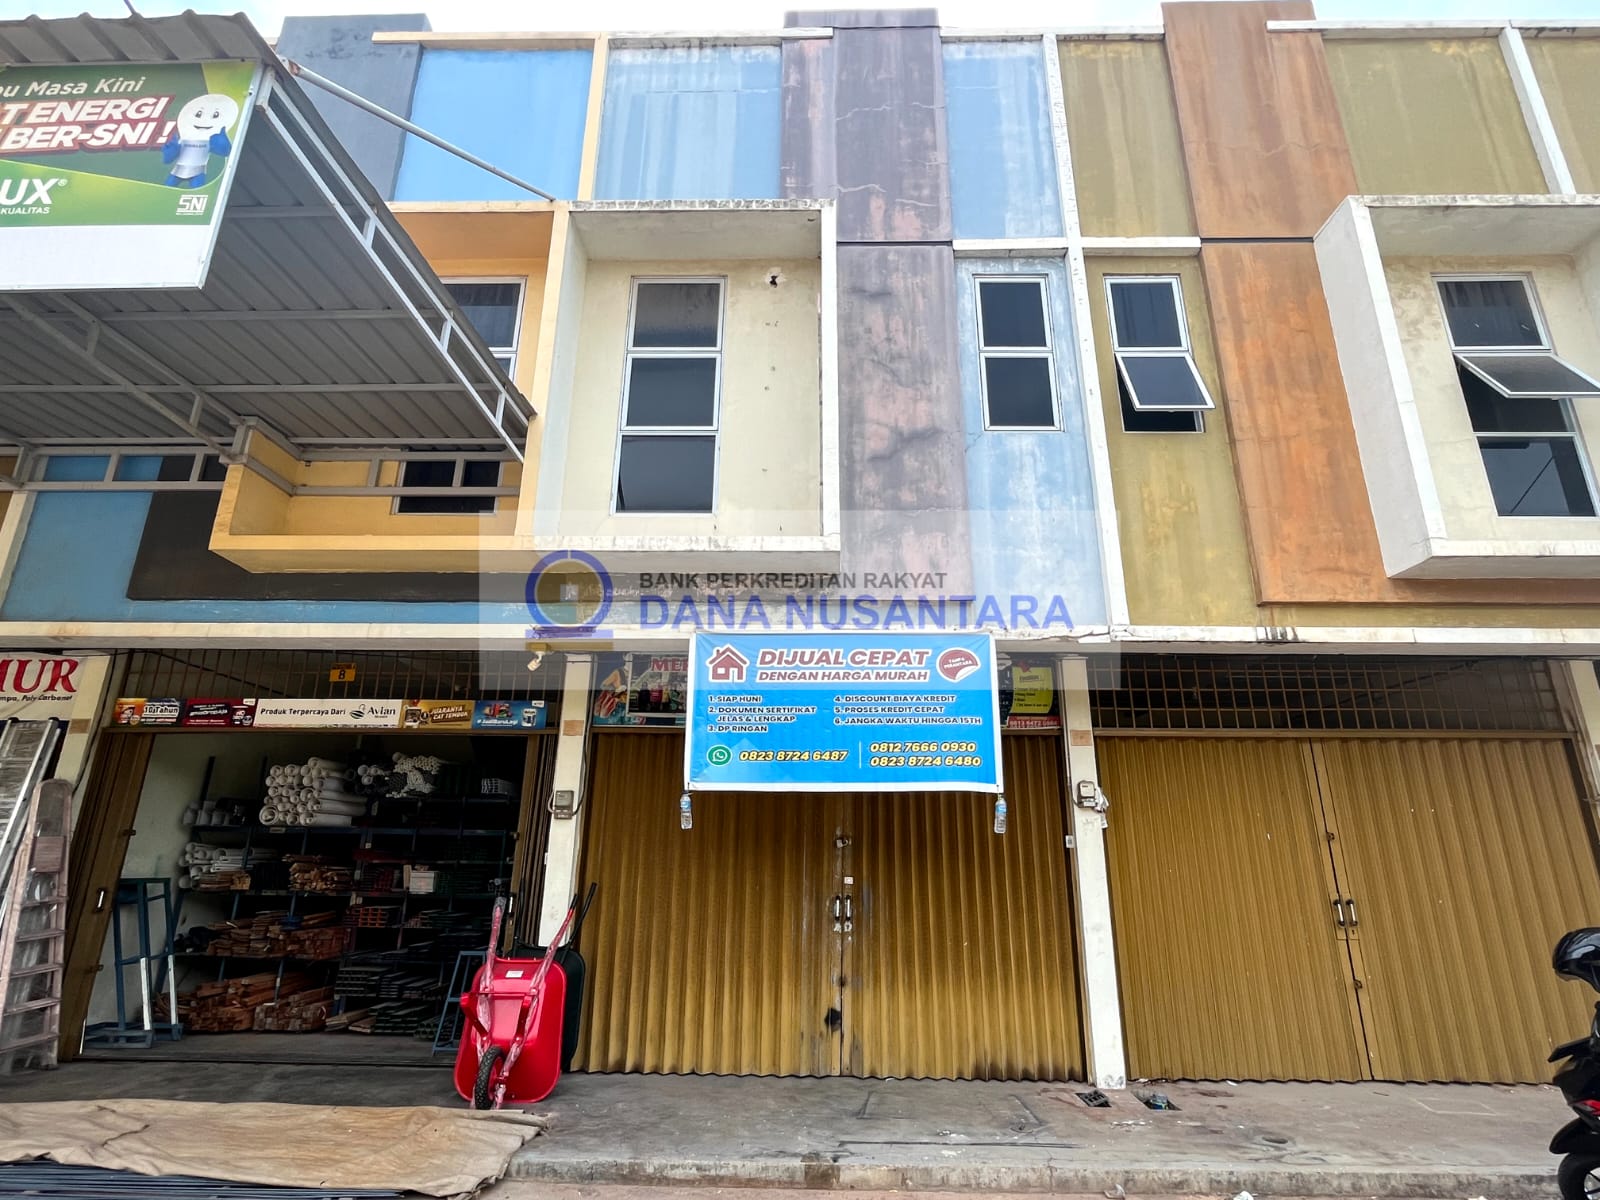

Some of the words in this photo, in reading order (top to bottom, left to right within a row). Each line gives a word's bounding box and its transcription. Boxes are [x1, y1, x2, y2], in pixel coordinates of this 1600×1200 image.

[25, 80, 88, 96] Masa
[94, 76, 145, 93] Kini
[27, 97, 167, 123] ENERGI
[1, 122, 154, 149] BER-SNI
[176, 195, 208, 212] SNI
[1, 206, 50, 215] KUALITAS
[759, 651, 844, 665] DIJUAL
[849, 651, 929, 665] CEPAT
[758, 671, 818, 681] DENGAN
[821, 671, 871, 681] HARGA
[875, 671, 928, 681] MURAH
[289, 708, 329, 716] Terpercaya
[367, 706, 396, 715] Avian
[870, 742, 901, 752] 0812
[905, 742, 937, 752] 7666
[941, 742, 976, 752] 0930
[739, 751, 773, 761] 0823
[776, 751, 810, 761] 8724
[812, 751, 848, 761] 6487
[870, 756, 904, 767] 0823
[908, 756, 942, 767] 8724
[945, 756, 981, 767] 6480
